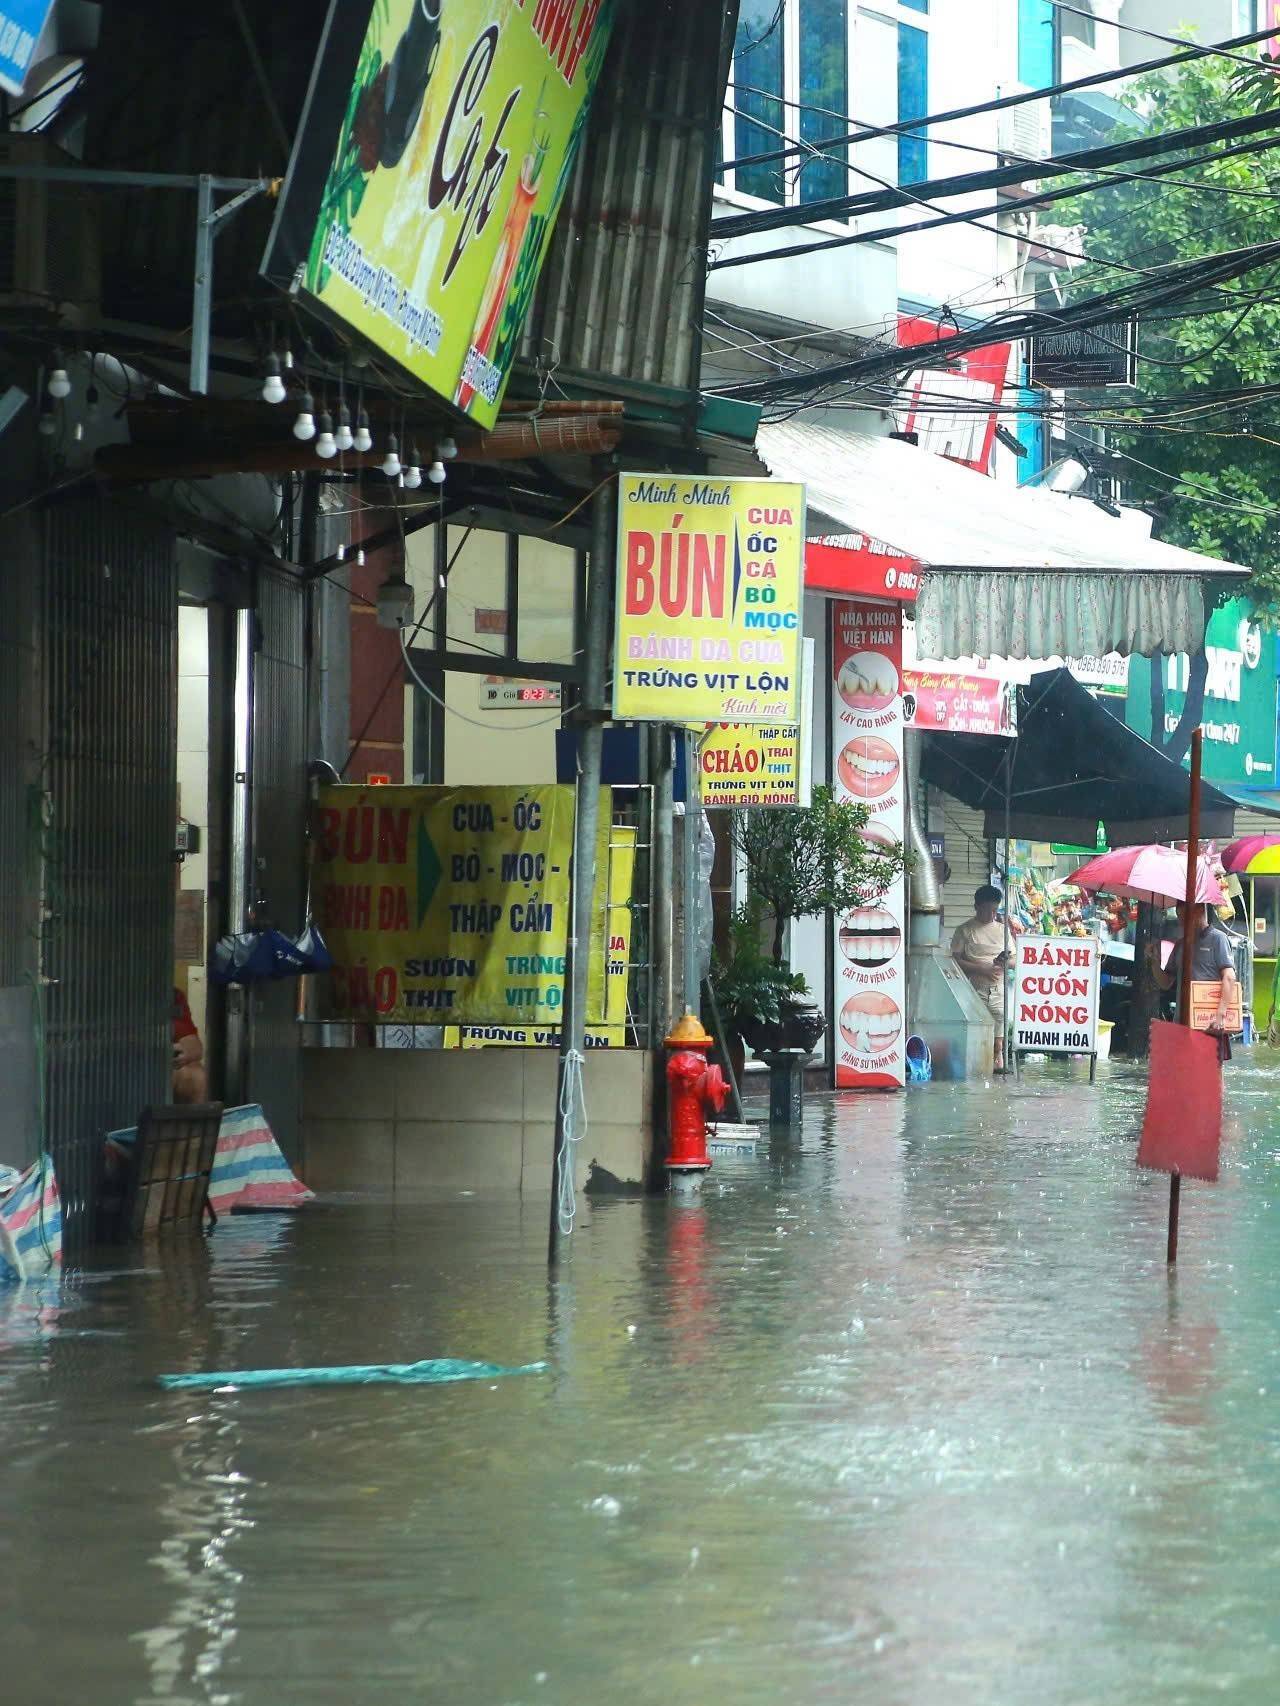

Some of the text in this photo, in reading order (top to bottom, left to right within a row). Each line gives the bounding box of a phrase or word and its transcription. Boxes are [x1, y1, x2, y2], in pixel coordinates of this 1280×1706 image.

[628, 481, 730, 505] Minh Minh
[747, 508, 793, 525] CUA
[747, 531, 777, 553] ỐC
[625, 513, 726, 618] BÚN
[746, 558, 776, 578] CÁ
[745, 586, 776, 603] BÒ
[744, 611, 797, 632] MỌC
[840, 612, 897, 626] NHA KHOA
[628, 633, 693, 661] BÁNH
[739, 640, 784, 663] CUA
[843, 628, 866, 646] VIỆT
[623, 667, 789, 694] TRỨNG VỊT LỘN
[768, 748, 793, 758] TRAI
[452, 793, 541, 832] CUA ỐC
[451, 847, 544, 888] BÒ MỌC
[1022, 942, 1091, 967] BÁNH
[1021, 969, 1089, 997] CUỐN
[1019, 1000, 1089, 1025] NÓNG
[1018, 1029, 1089, 1048] THANH HÓA
